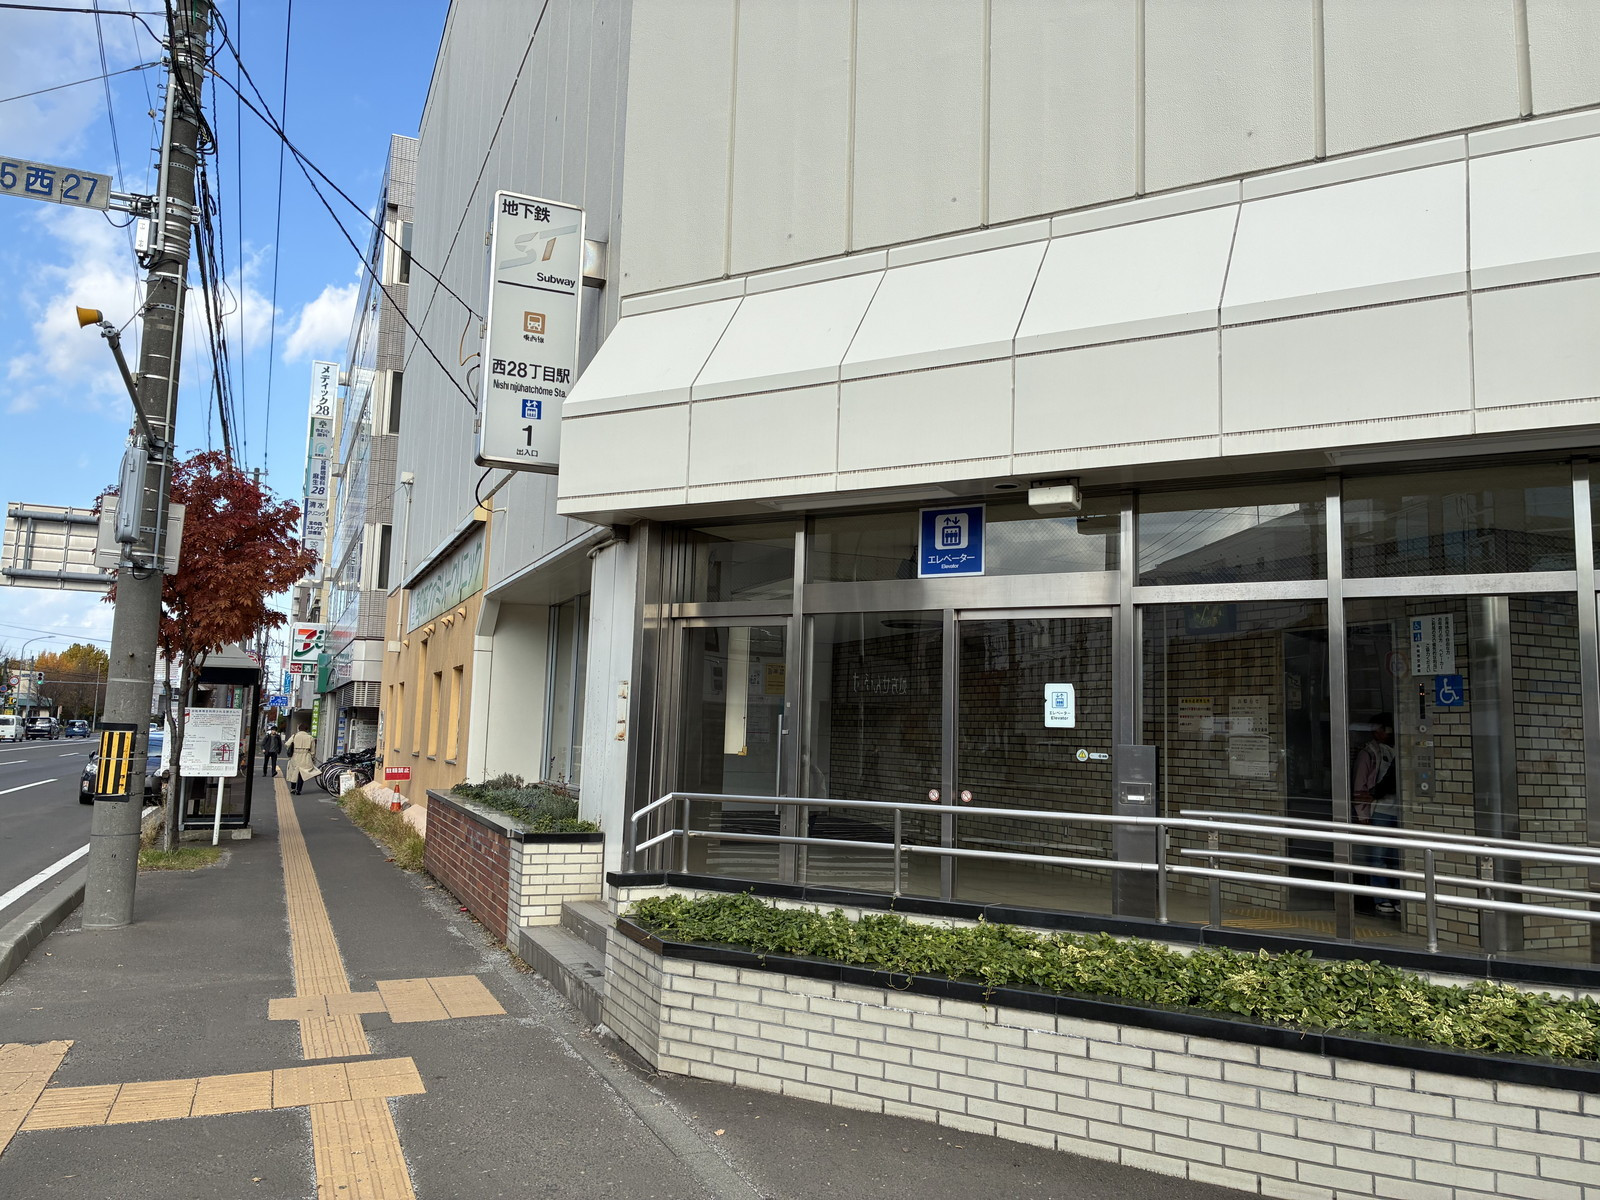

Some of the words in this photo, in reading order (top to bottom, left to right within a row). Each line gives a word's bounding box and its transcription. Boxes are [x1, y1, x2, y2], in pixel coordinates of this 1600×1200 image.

[502, 199, 550, 223] 地下鉄
[537, 272, 576, 288] Subway
[492, 358, 570, 385] 西28丁目駅
[554, 387, 568, 398] Sta.
[522, 424, 533, 447] 1
[516, 449, 539, 458] 出入口
[928, 553, 976, 564] エレベーター
